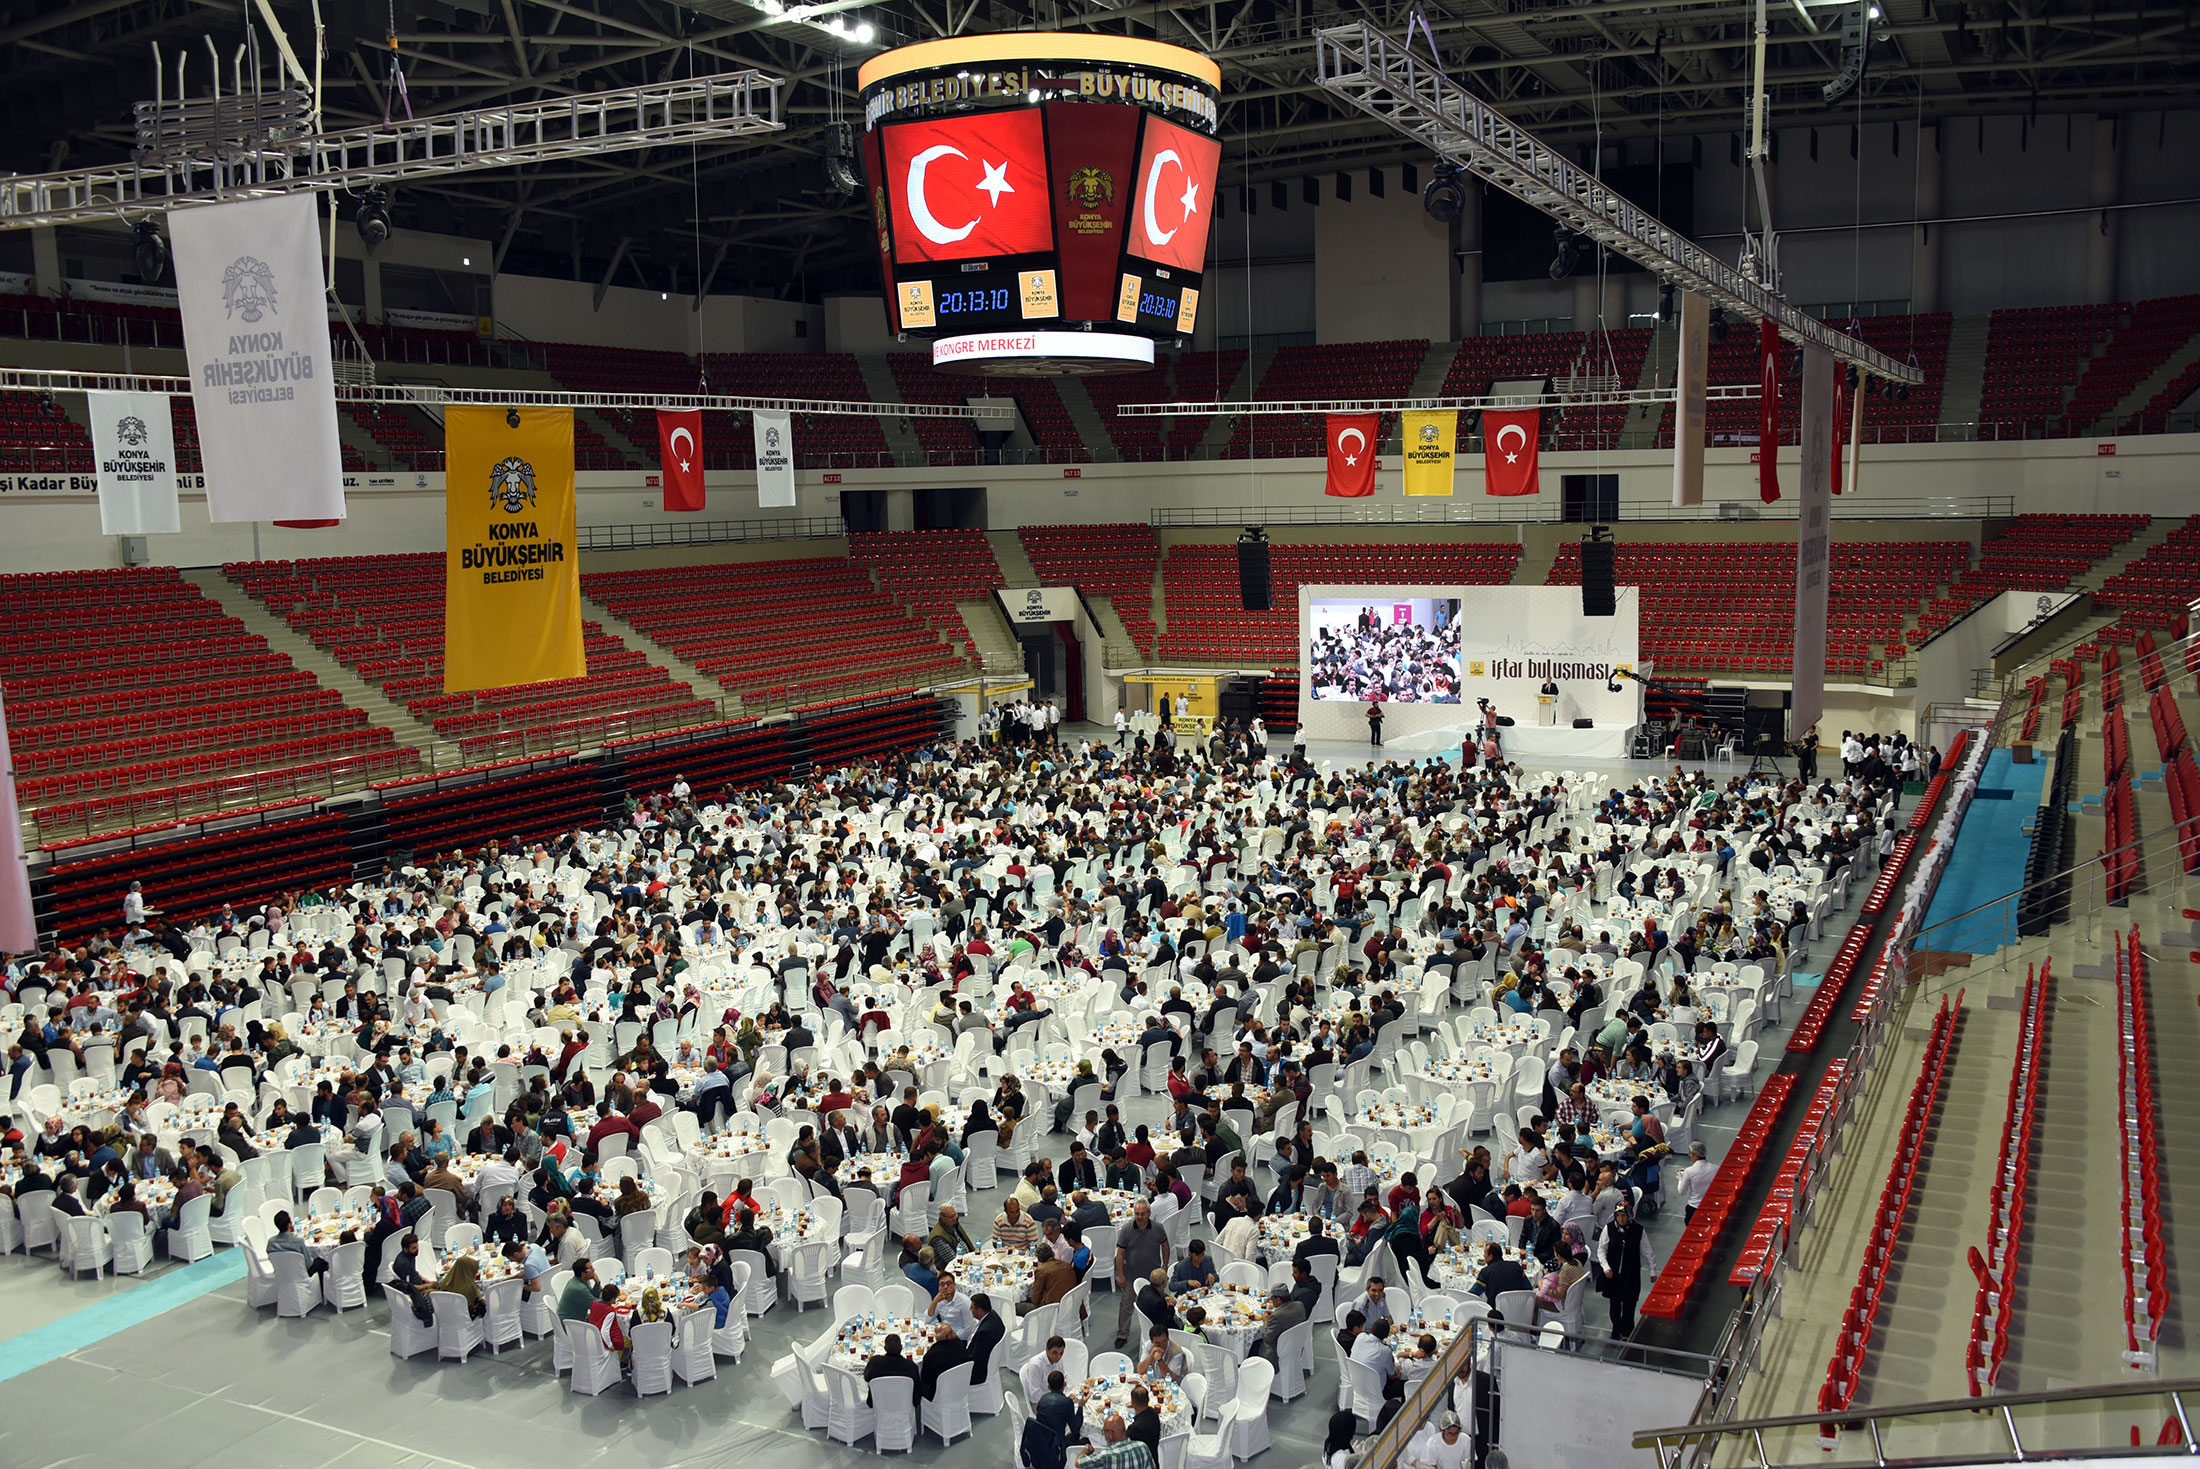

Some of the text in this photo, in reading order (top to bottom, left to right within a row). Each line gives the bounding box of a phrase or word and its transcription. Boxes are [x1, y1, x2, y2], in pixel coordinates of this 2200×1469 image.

[896, 65, 1029, 110] BELEDİYESİ
[1080, 68, 1206, 117] BÜYÜKŞEHİR
[1068, 220, 1112, 229] BÜYÜKŞEHİR
[940, 340, 974, 356] KONGRE
[978, 334, 1036, 352] MERKEZİ
[118, 450, 150, 459] KONYA
[1408, 450, 1450, 460] BÜYÜKŞEHİR
[103, 460, 166, 474] BÜYÜKŞEHİR
[18, 477, 66, 490] Kadar
[70, 476, 98, 492] Büy
[117, 474, 154, 482] BELEDİYESİ
[489, 522, 539, 540] KONYA
[462, 538, 564, 569] BÜYÜKŞEHİR
[483, 565, 544, 584] BELEDİYESİ
[1492, 658, 1609, 681] iftar buluşması
